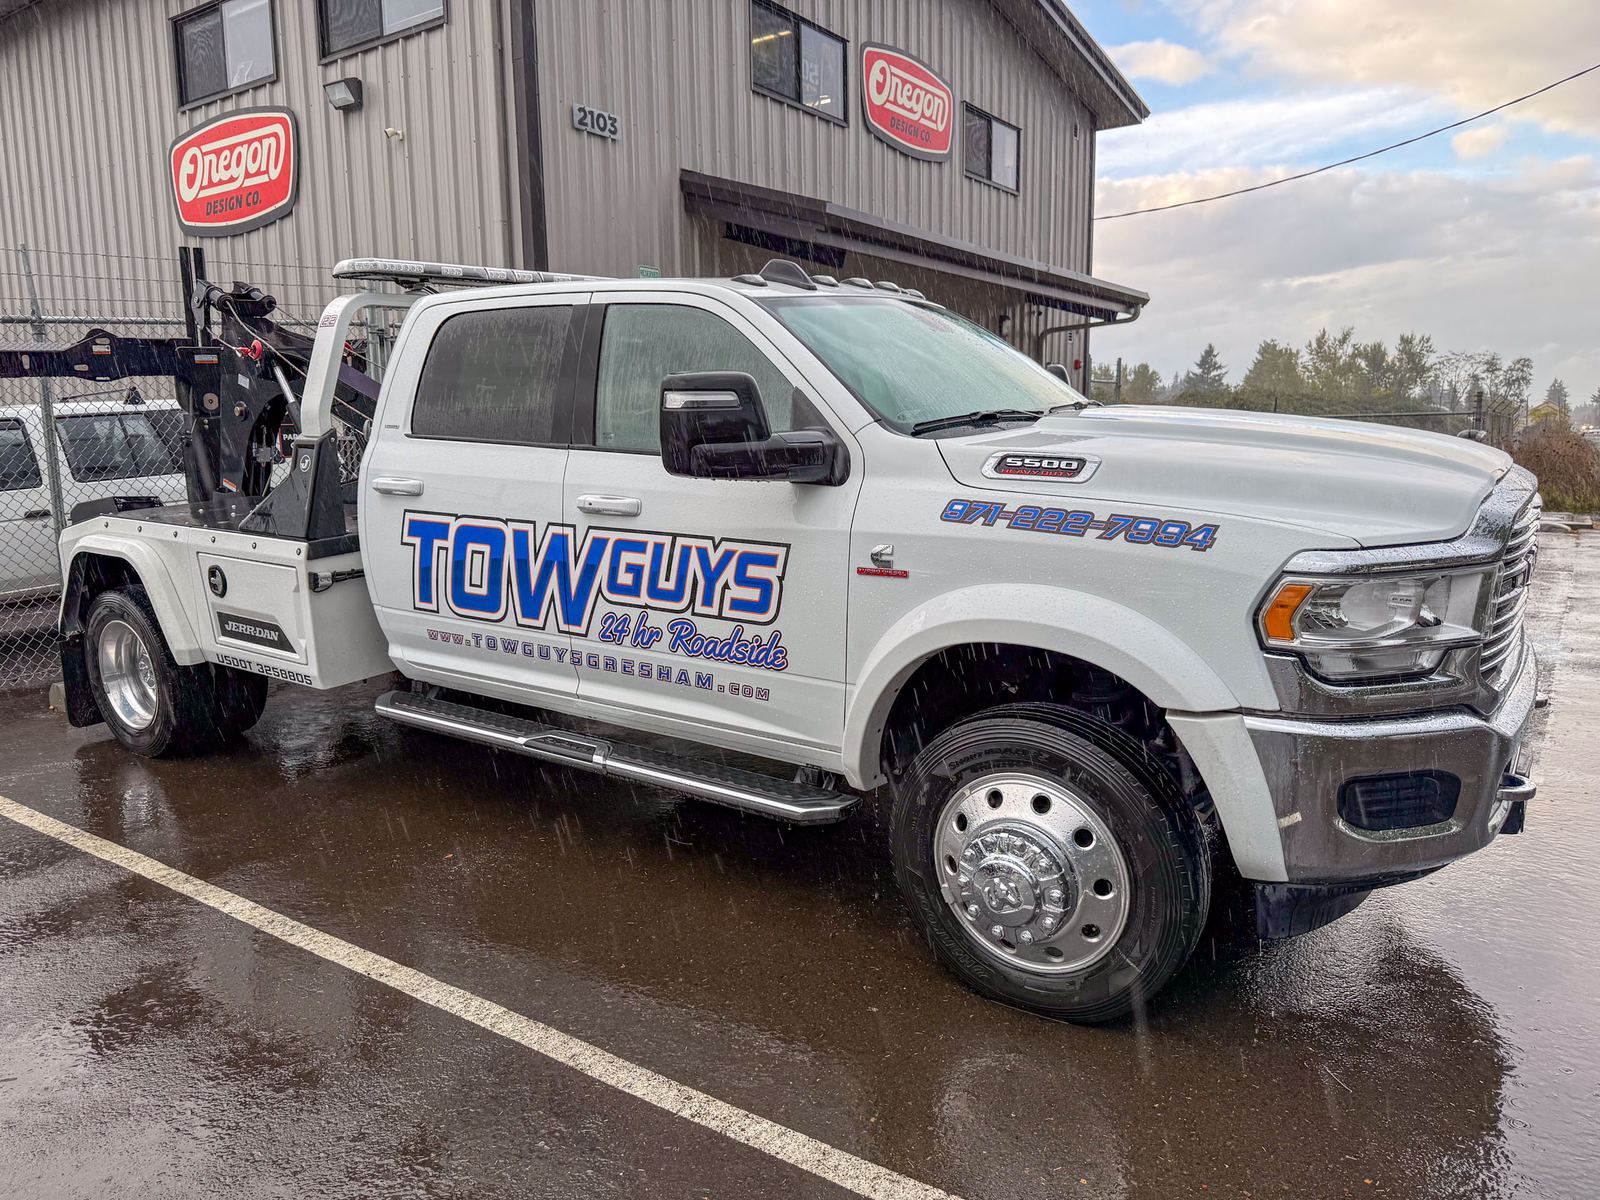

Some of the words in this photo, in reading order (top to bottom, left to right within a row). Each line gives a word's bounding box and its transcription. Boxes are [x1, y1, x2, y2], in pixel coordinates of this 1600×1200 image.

[577, 106, 618, 136] 2103
[889, 117, 919, 138] DESIGN
[920, 130, 932, 143] CO.
[205, 194, 243, 216] DESIGN
[245, 190, 262, 206] CO.
[1006, 457, 1079, 470] 5500
[940, 498, 1220, 552] 971-222-7994
[599, 611, 632, 645] 24
[631, 610, 663, 648] hr
[667, 617, 789, 671] Roadside
[216, 652, 254, 671] USDOT
[256, 662, 313, 686] 3258805
